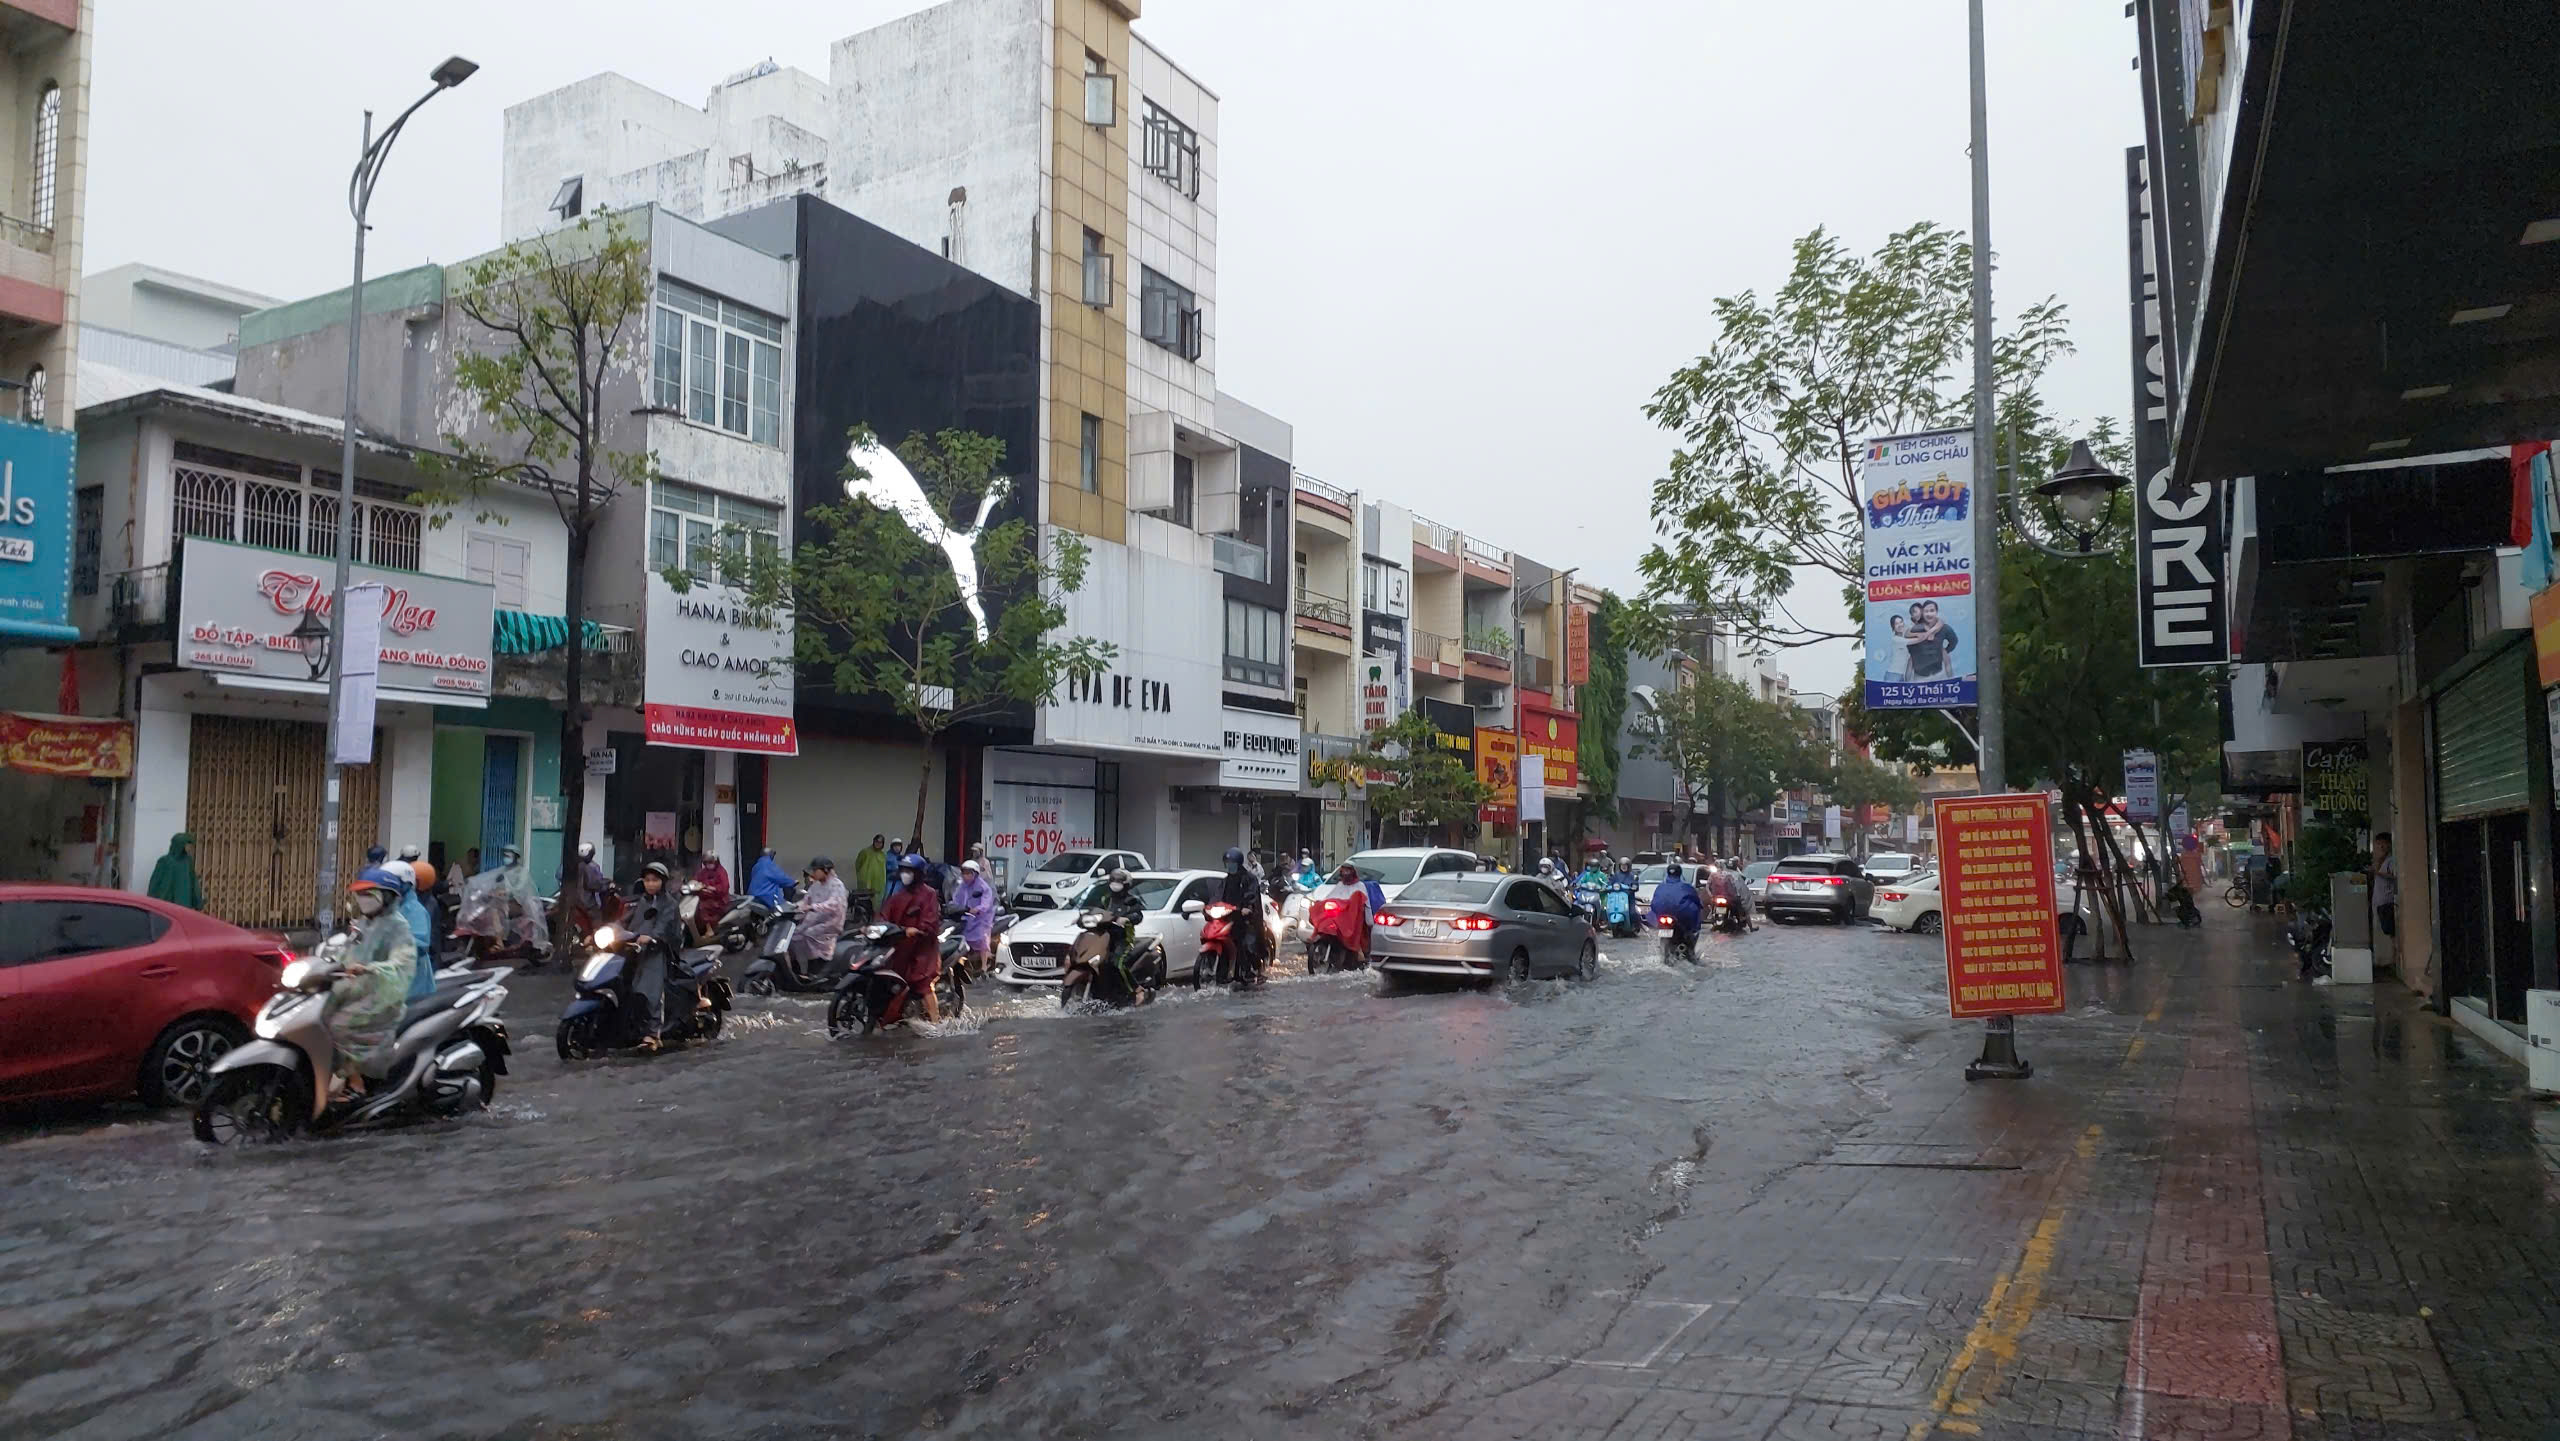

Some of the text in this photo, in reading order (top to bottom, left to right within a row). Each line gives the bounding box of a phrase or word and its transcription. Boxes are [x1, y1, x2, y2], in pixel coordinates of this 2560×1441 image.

[1895, 445, 1969, 465] LONG CHÂU
[1872, 471, 1967, 509] GIÁ TỐT
[1898, 503, 1940, 528] Thật
[1886, 541, 1951, 558] VẮC XIN
[1869, 557, 1970, 577] CHÍNH HÃNG
[1869, 583, 1902, 597] LUÔN
[1933, 579, 1970, 593] HÀNG
[679, 599, 726, 623] HANA
[722, 633, 730, 645] &
[414, 650, 443, 666] MÙA
[449, 655, 487, 672] ĐÔNG
[681, 649, 719, 669] CIAO
[1113, 674, 1132, 708] DE
[1142, 679, 1171, 713] EVA
[1880, 685, 1899, 697] 125
[1902, 685, 1915, 699] Lý
[1917, 683, 1943, 696] Thái
[652, 720, 671, 733] CHÀO
[1224, 731, 1241, 749] HP
[1243, 733, 1300, 757] BOUTIQUE
[1032, 811, 1056, 824] SALE
[995, 834, 1017, 848] OFF
[1024, 829, 1066, 855] 50%
